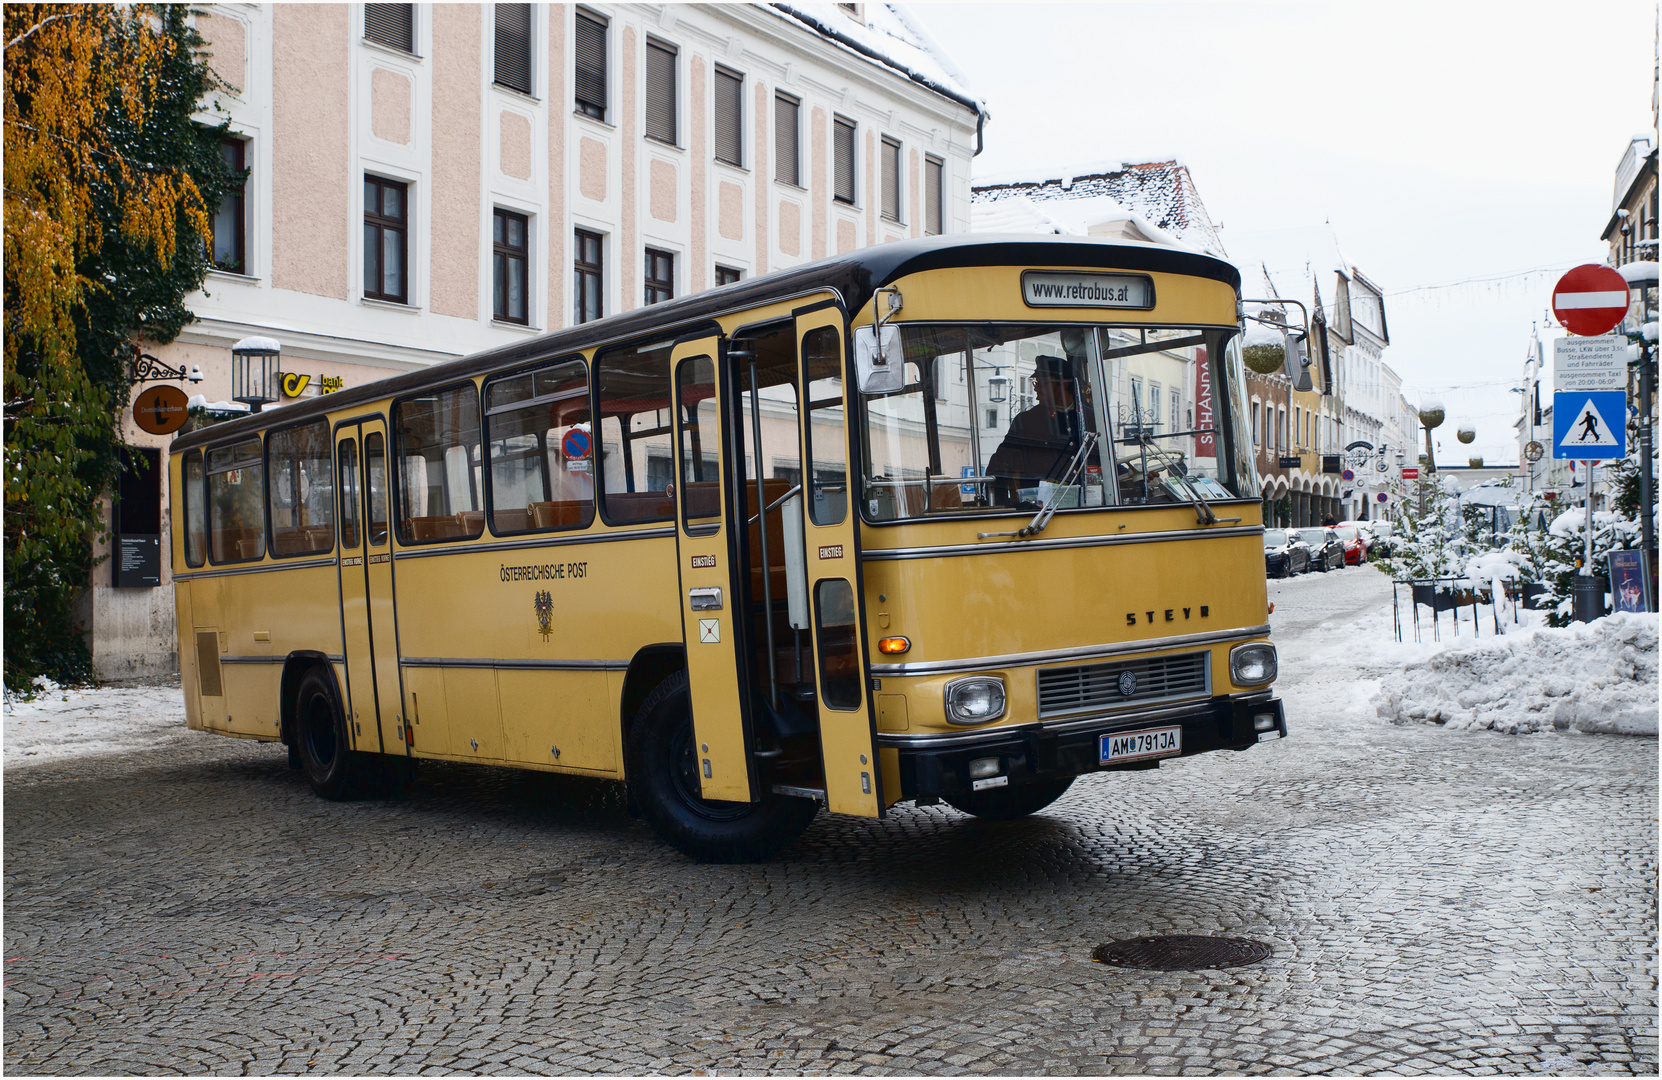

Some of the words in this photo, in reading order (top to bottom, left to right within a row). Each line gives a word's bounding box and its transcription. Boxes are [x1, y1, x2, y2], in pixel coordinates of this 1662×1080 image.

[1032, 282, 1129, 302] www.retrobus.at
[1566, 338, 1615, 346] ausgenommen
[1567, 353, 1614, 361] Straßendienst
[320, 373, 344, 387] bank
[820, 546, 842, 558] EINSTIEG
[692, 556, 715, 567] EINSTIEG
[500, 564, 565, 582] ÖSTERREICHISCHE
[567, 562, 588, 578] POST
[1126, 605, 1210, 626] STEYR
[1112, 738, 1129, 756] AM
